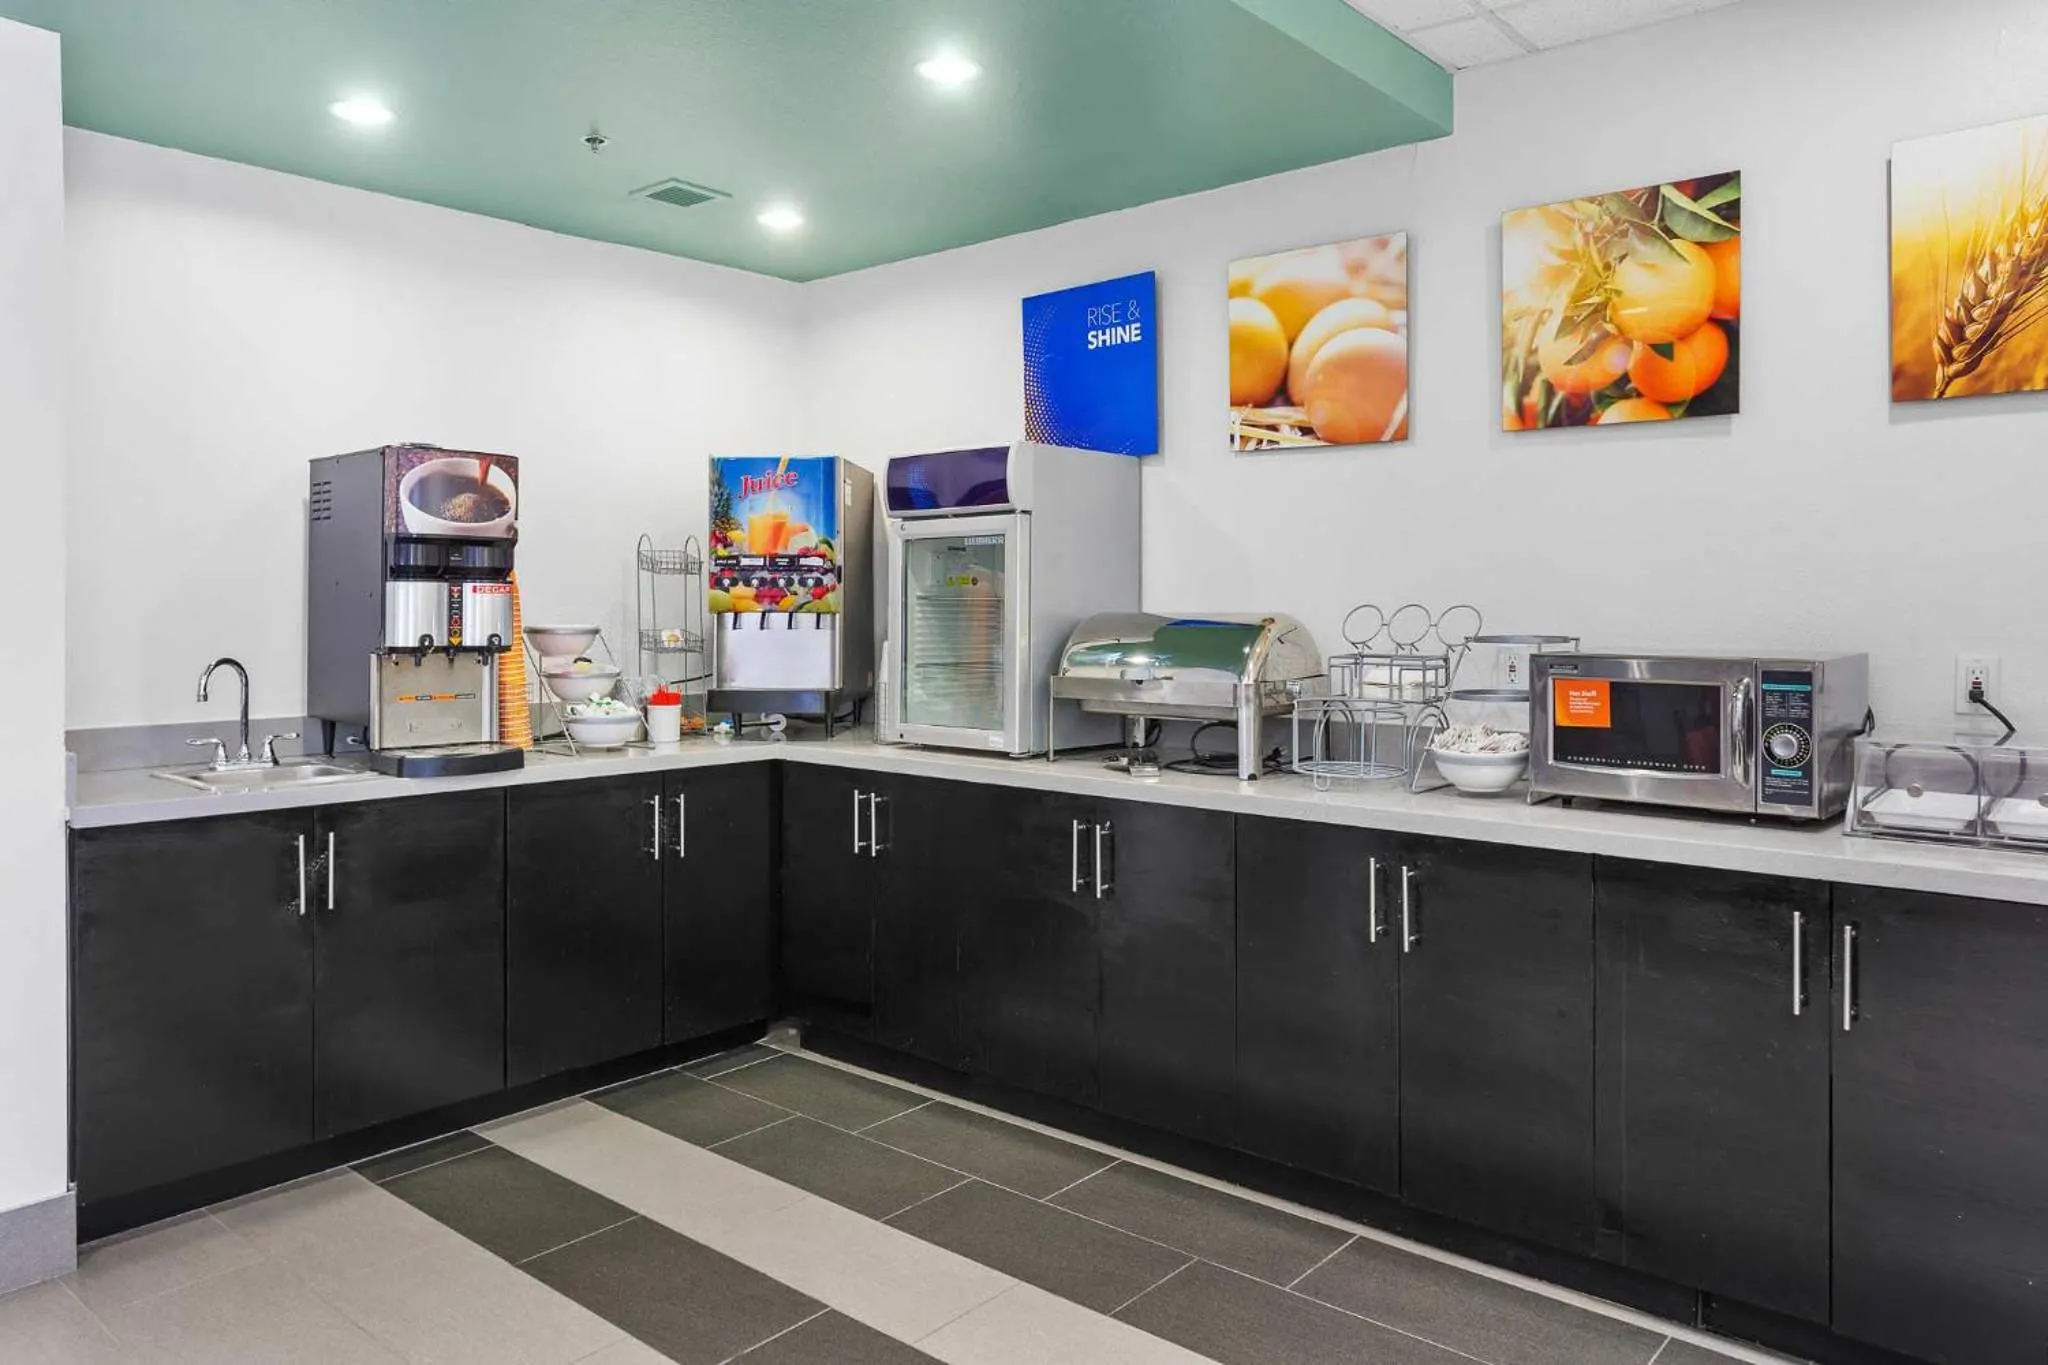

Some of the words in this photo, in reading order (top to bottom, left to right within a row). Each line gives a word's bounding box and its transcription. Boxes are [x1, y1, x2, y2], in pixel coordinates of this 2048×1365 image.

[1087, 302, 1121, 328] RISE
[1127, 299, 1140, 320] &
[1087, 322, 1142, 350] SHINE
[737, 470, 799, 500] Juice
